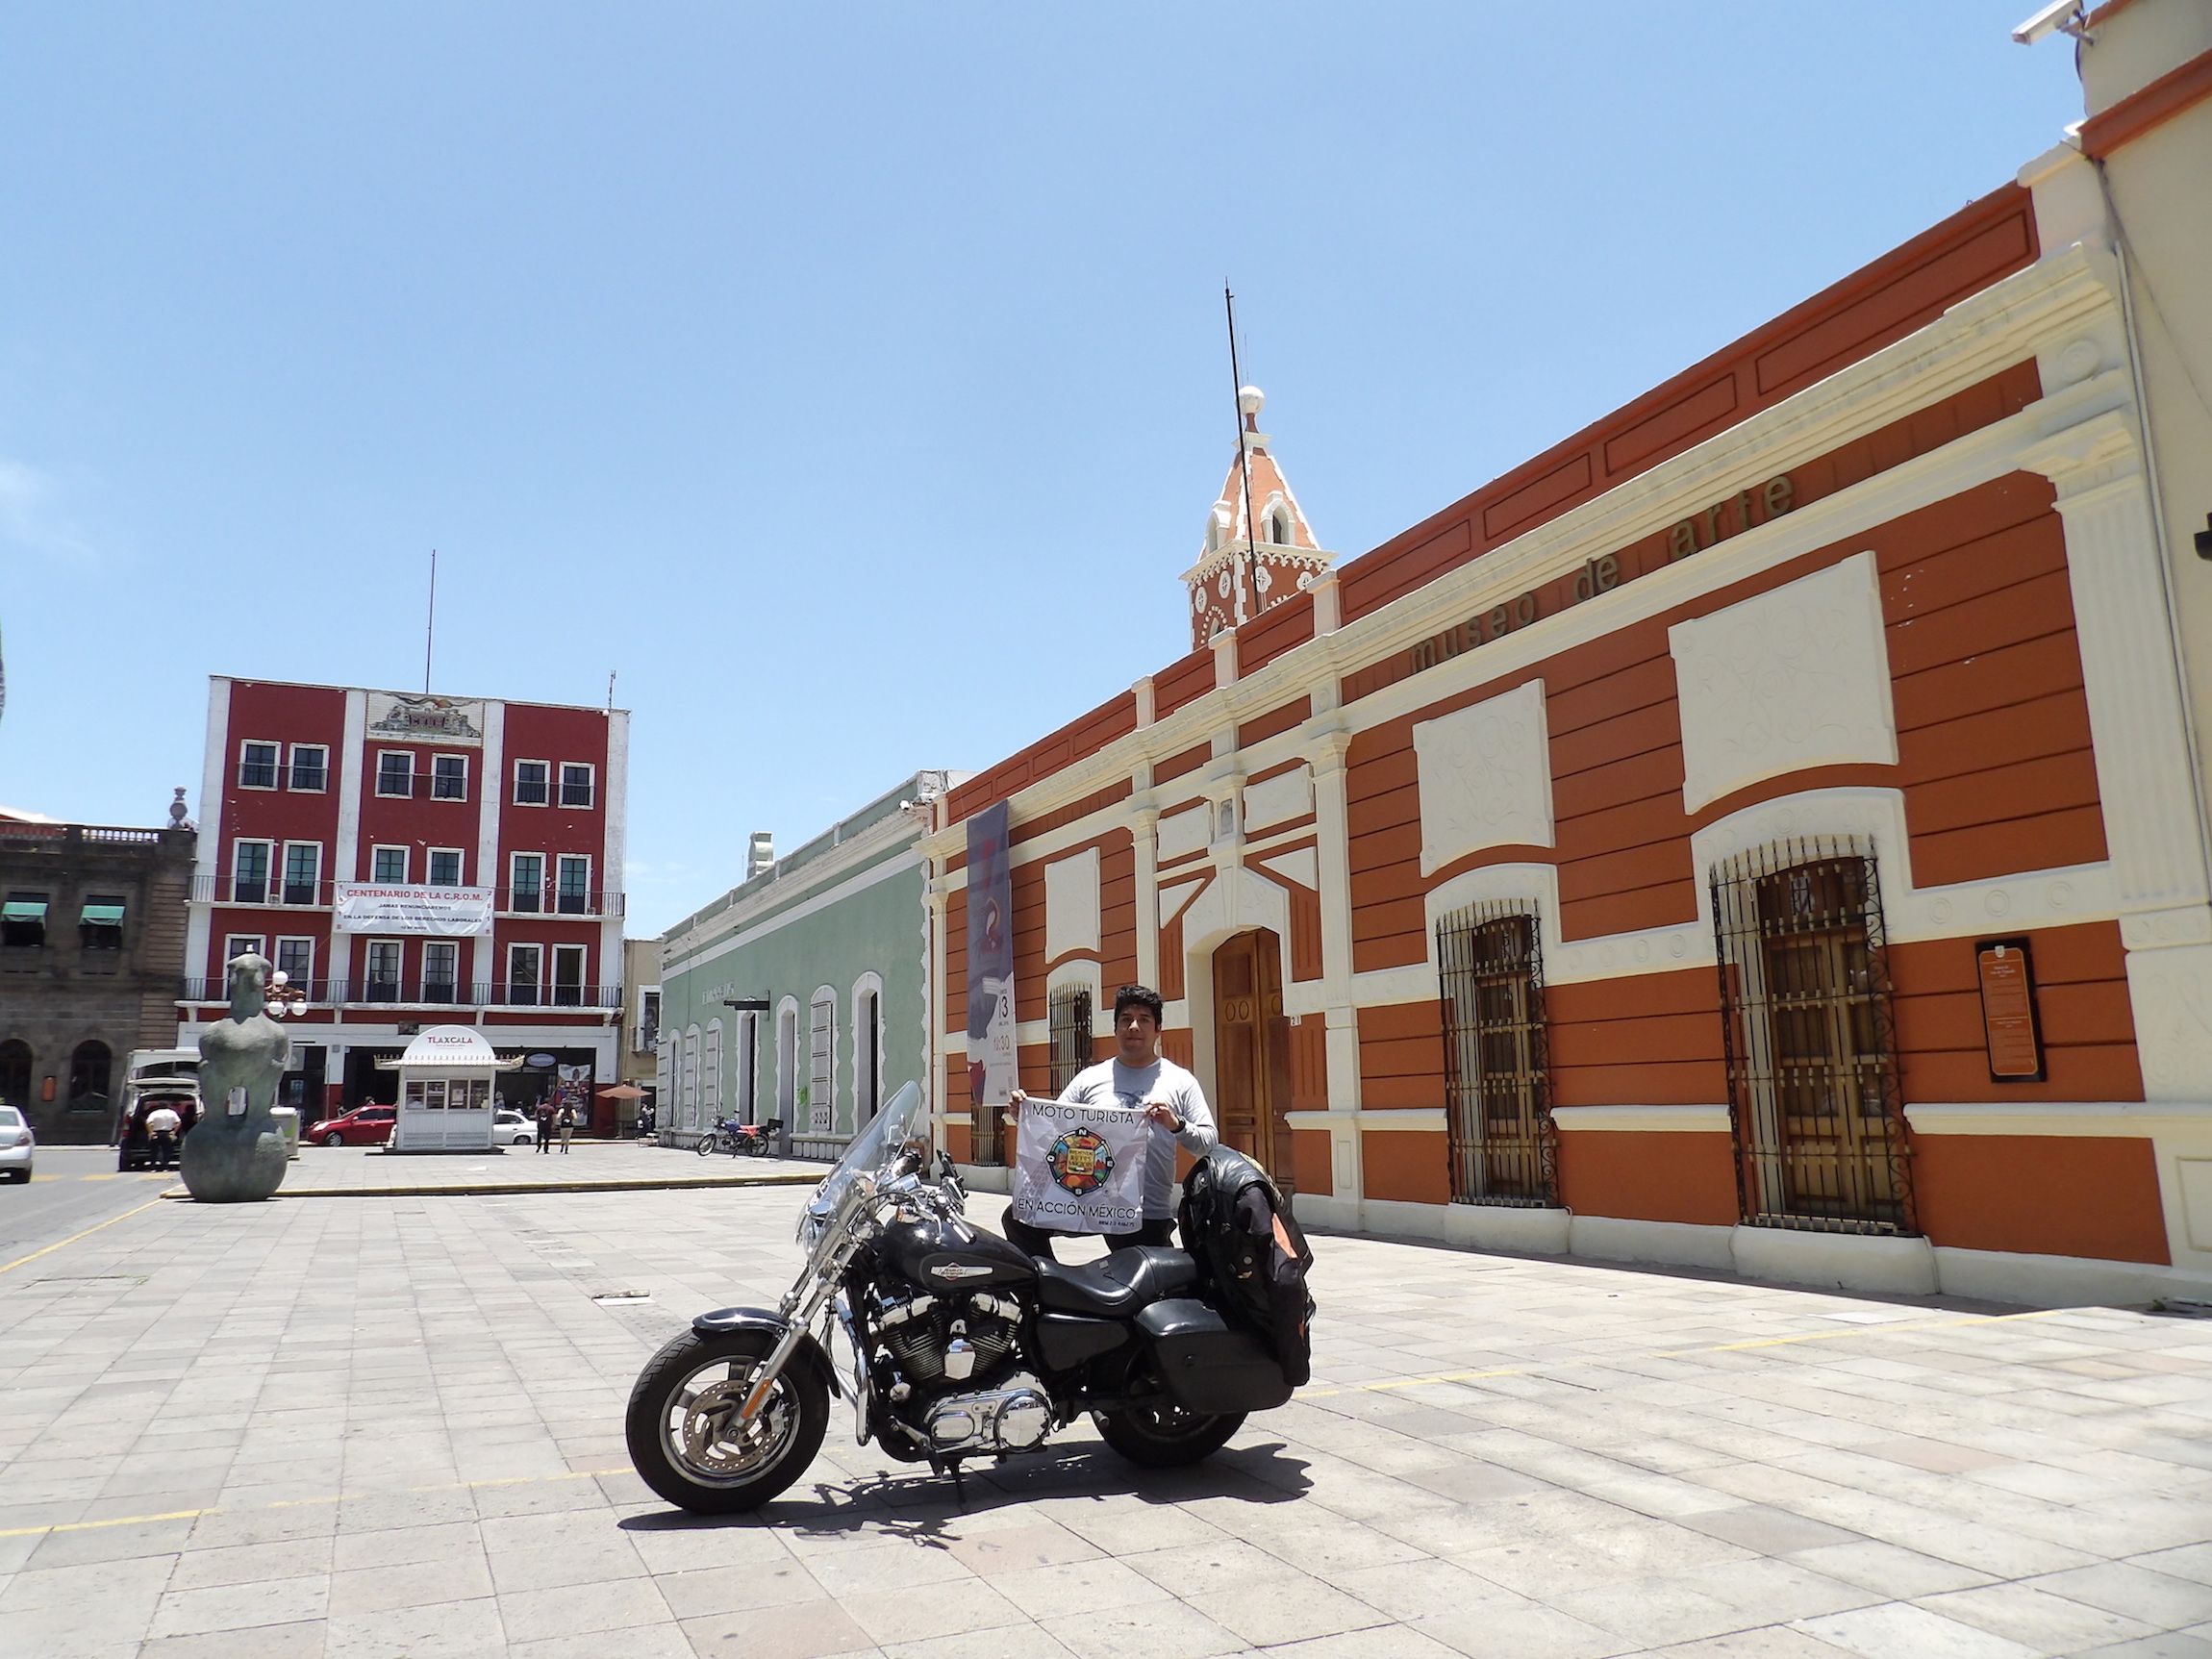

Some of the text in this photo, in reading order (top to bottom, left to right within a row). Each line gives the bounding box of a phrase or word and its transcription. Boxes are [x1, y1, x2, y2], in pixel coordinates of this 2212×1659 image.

[1410, 474, 1796, 673] museo de arte
[346, 889, 411, 898] CENTENARIO
[414, 891, 427, 899] DE
[443, 892, 483, 901] C.R.O.M.
[998, 994, 1009, 1018] 13
[427, 1036, 473, 1044] TLAXCALA
[1032, 1103, 1135, 1124] MOTO TURISTA
[1018, 1197, 1136, 1220] EN ACCIÓN MÉXICO
